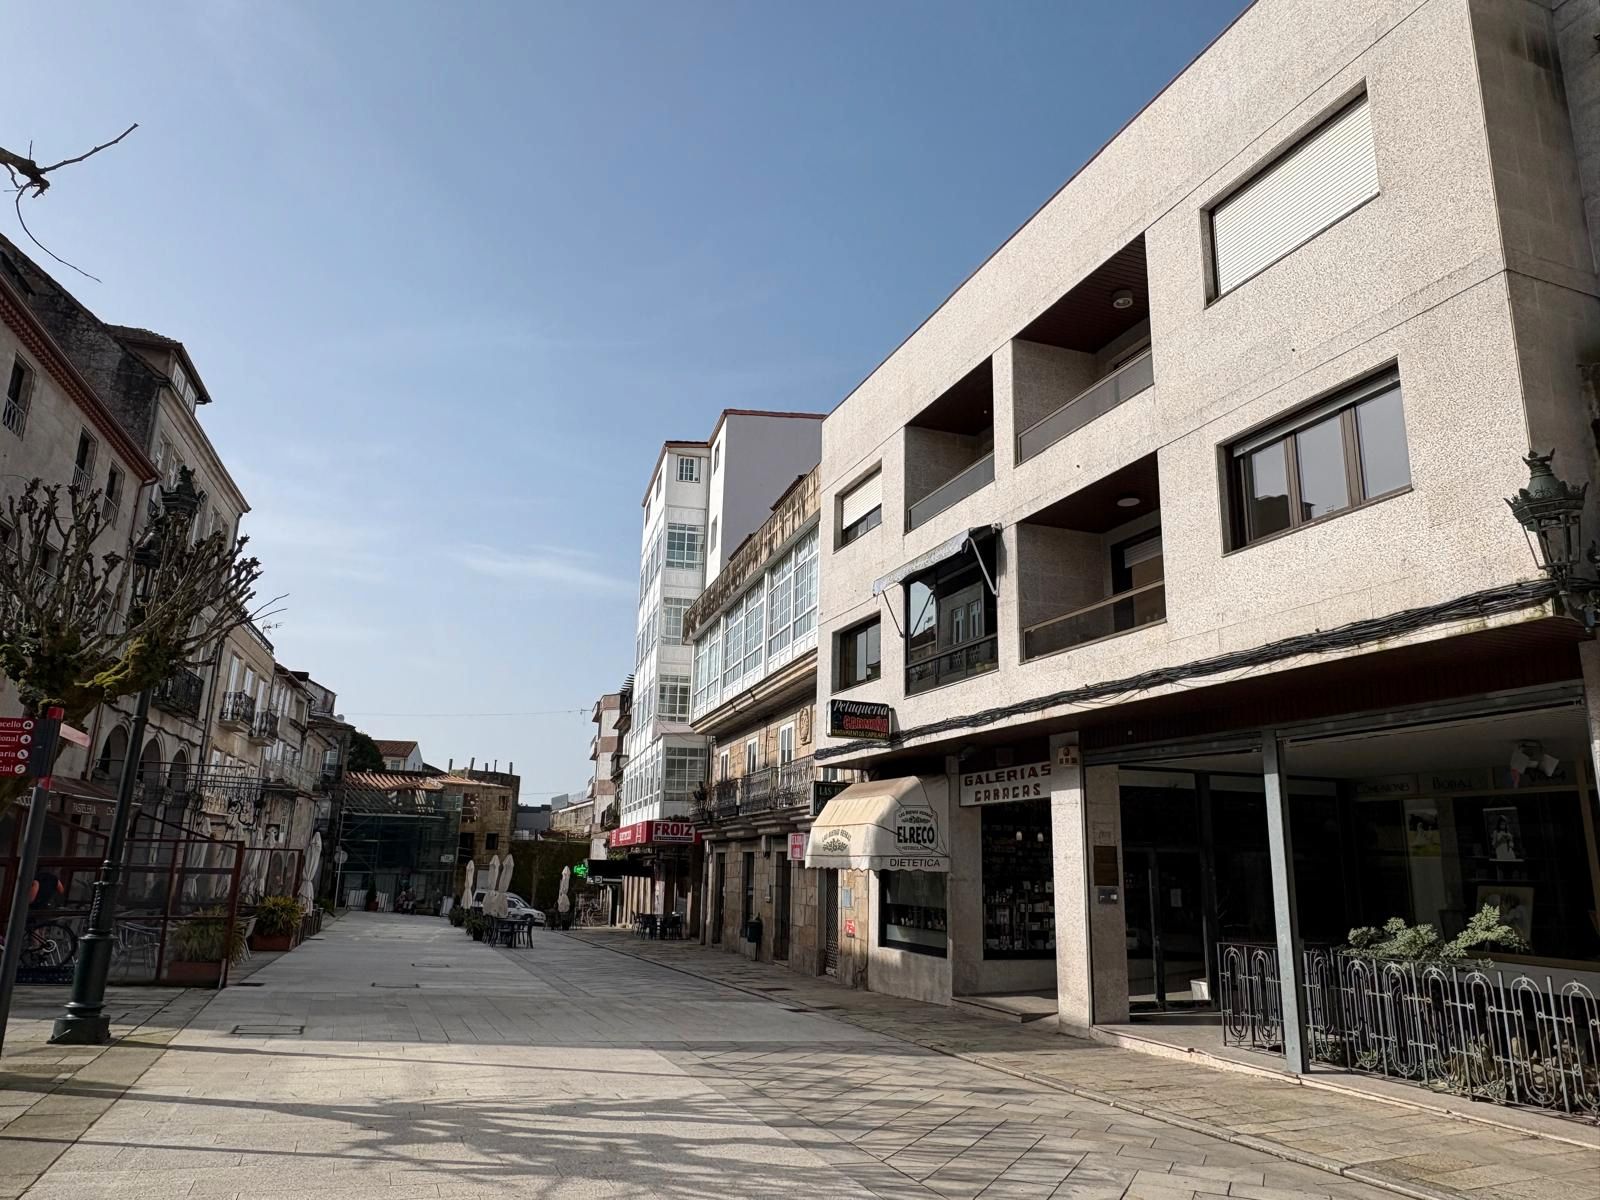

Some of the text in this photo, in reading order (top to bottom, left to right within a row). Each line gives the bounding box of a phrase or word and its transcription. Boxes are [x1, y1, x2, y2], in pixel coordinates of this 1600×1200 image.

[964, 763, 1051, 787] GALERIAS
[974, 783, 1041, 802] CARACAS
[654, 823, 692, 837] FROIZ
[889, 858, 941, 868] DIETETICA
